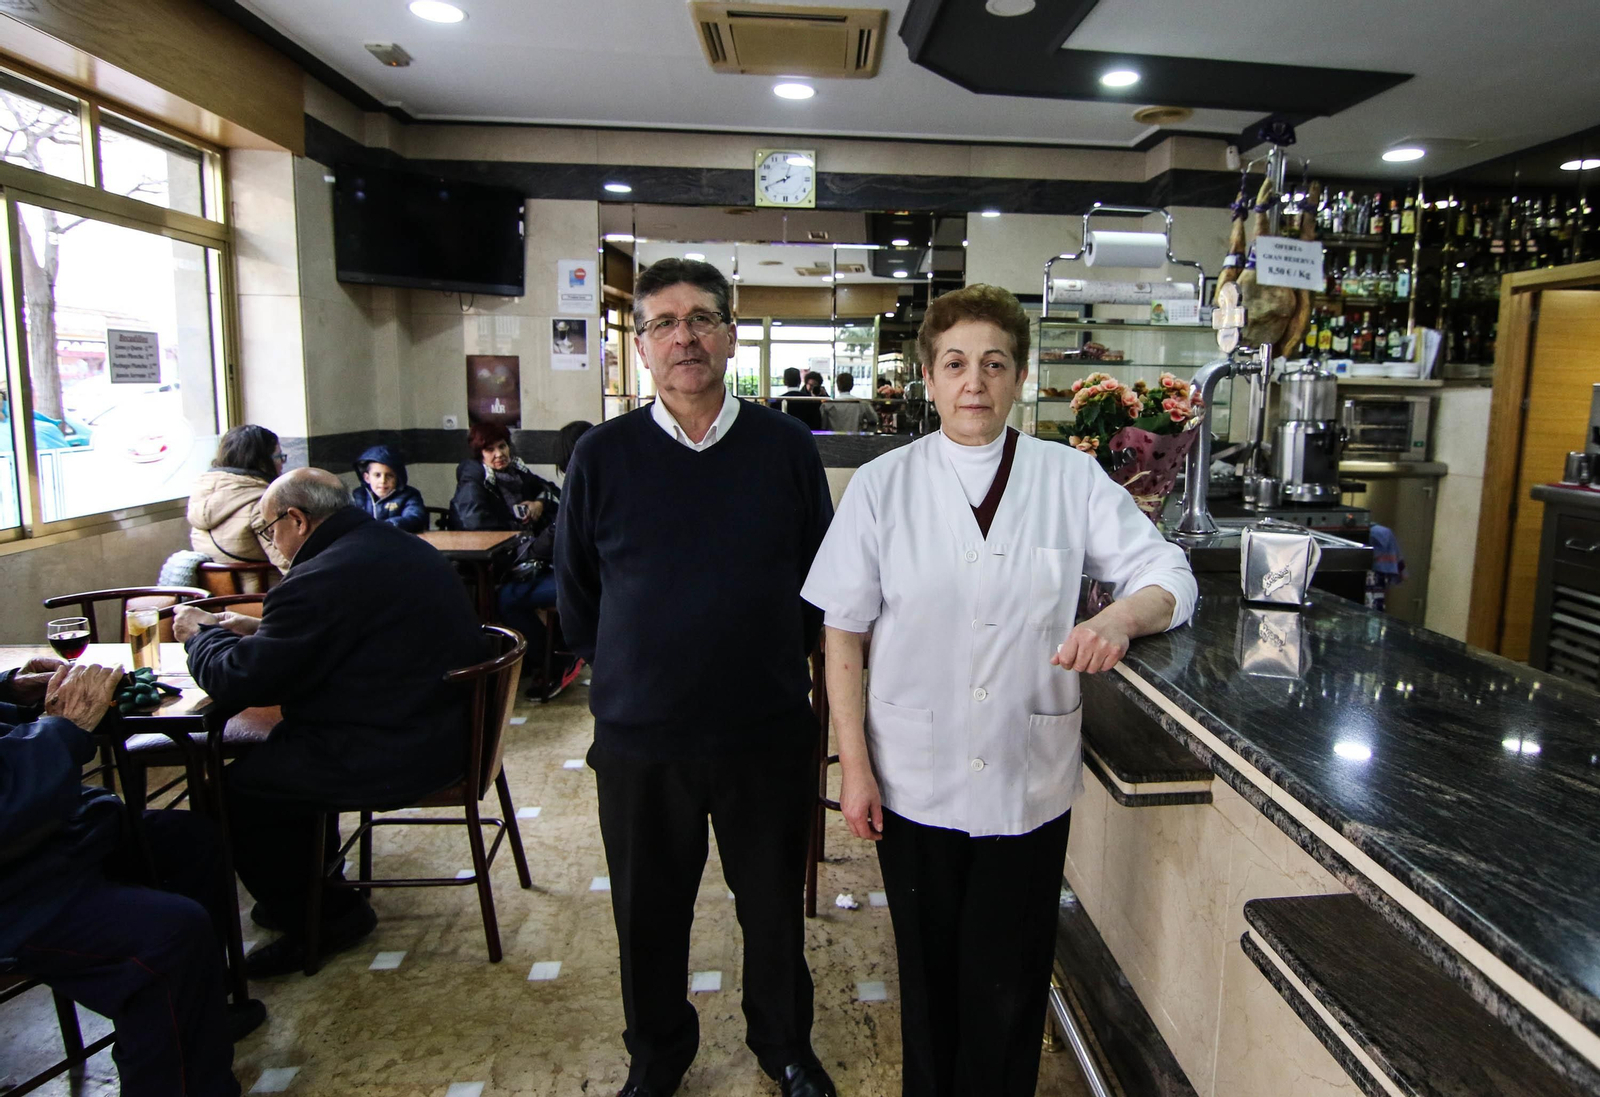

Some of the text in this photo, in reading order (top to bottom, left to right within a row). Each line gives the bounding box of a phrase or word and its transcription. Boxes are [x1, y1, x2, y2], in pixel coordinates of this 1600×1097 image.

[1274, 243, 1303, 252] OFERTA
[1262, 253, 1315, 265] GRAN RESERVA
[1299, 269, 1311, 280] Kg
